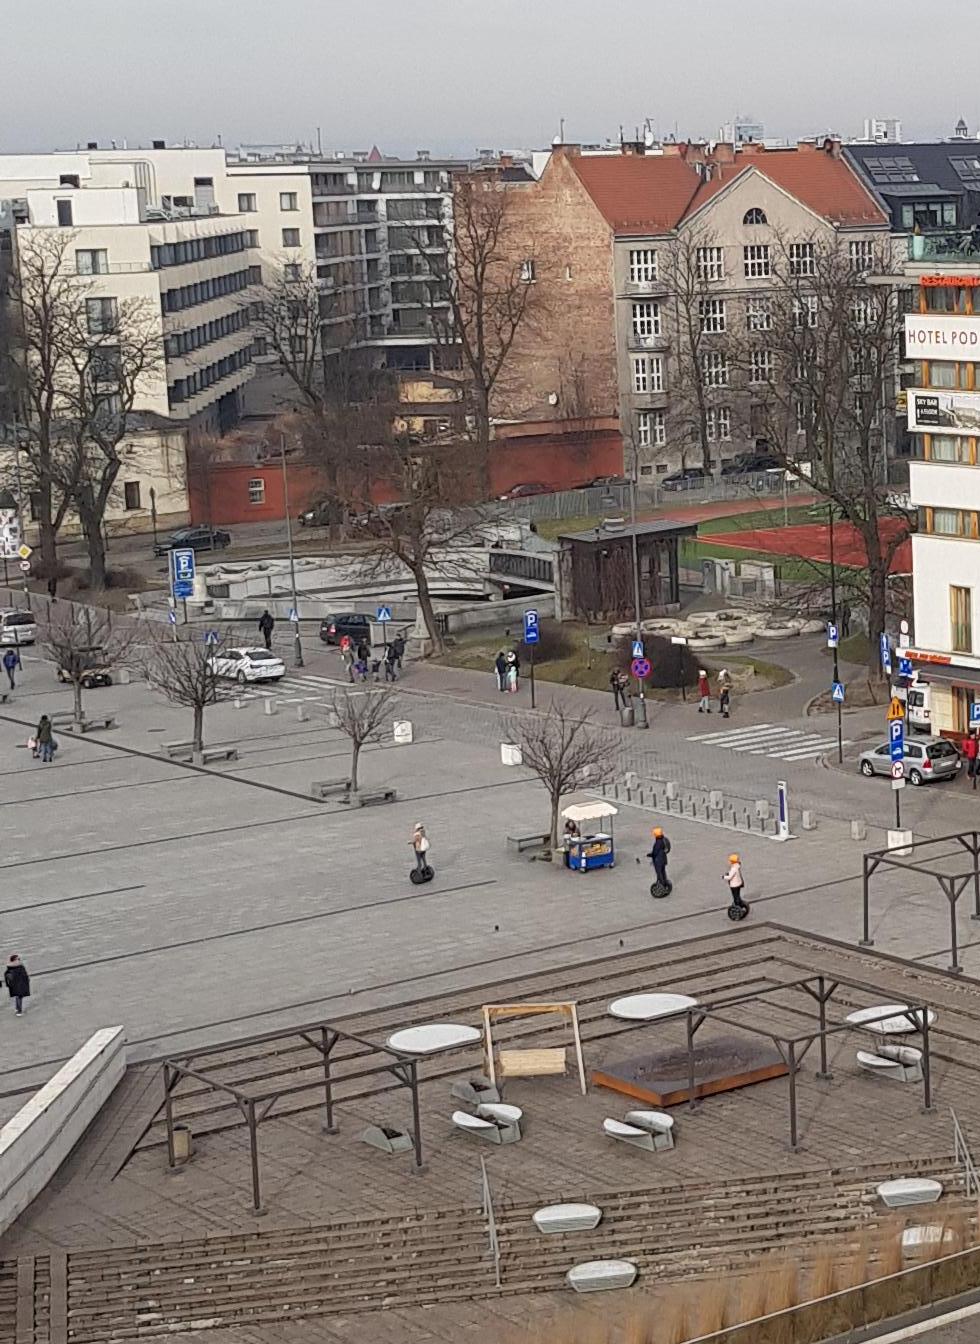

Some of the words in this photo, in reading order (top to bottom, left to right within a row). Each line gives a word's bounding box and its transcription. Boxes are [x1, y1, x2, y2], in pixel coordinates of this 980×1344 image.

[908, 329, 947, 344] HOTEL
[951, 331, 978, 345] POD
[892, 725, 901, 740] P
